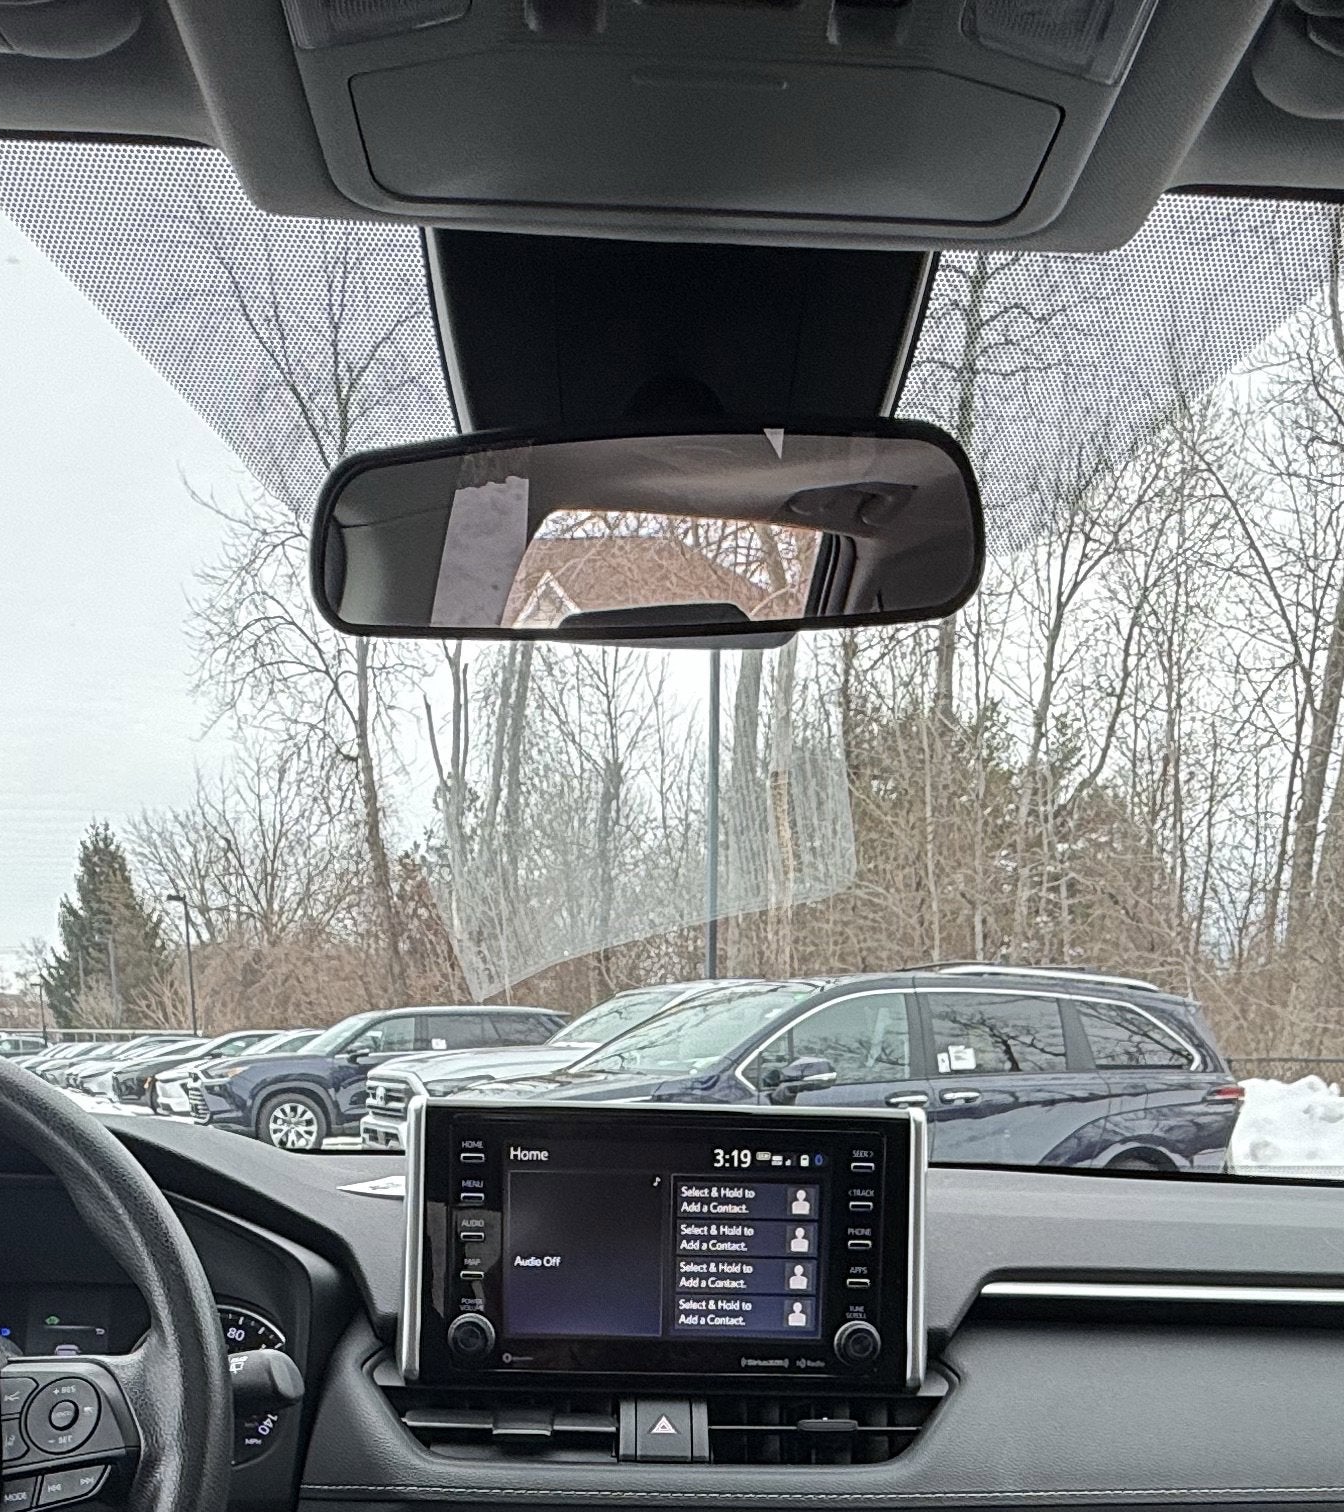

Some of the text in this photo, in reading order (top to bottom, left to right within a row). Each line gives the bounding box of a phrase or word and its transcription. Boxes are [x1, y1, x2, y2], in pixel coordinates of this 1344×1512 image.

[461, 1141, 484, 1149] HOME
[509, 1147, 549, 1161] Home
[713, 1149, 752, 1168] 3:19
[461, 1180, 484, 1188] MENU
[680, 1186, 756, 1199] Select & Hold to
[680, 1202, 701, 1213] Add
[709, 1202, 749, 1213] Contact.
[460, 1219, 485, 1227] AUDIO
[680, 1224, 755, 1236] Select & Hold to
[847, 1228, 872, 1236] PHONE
[679, 1240, 700, 1250] Add
[708, 1240, 748, 1251] Contact.
[513, 1255, 561, 1267] Audio Off
[679, 1262, 753, 1274] Select & Hold to
[849, 1266, 868, 1274] APPS
[678, 1277, 699, 1288] Add
[707, 1277, 747, 1288] Contact.
[678, 1299, 752, 1311] Select & Hold to
[678, 1314, 698, 1325] Add
[706, 1314, 746, 1326] Contact.
[226, 1327, 245, 1341] 80
[258, 1413, 278, 1435] 140
[4, 1491, 28, 1502] MODE
